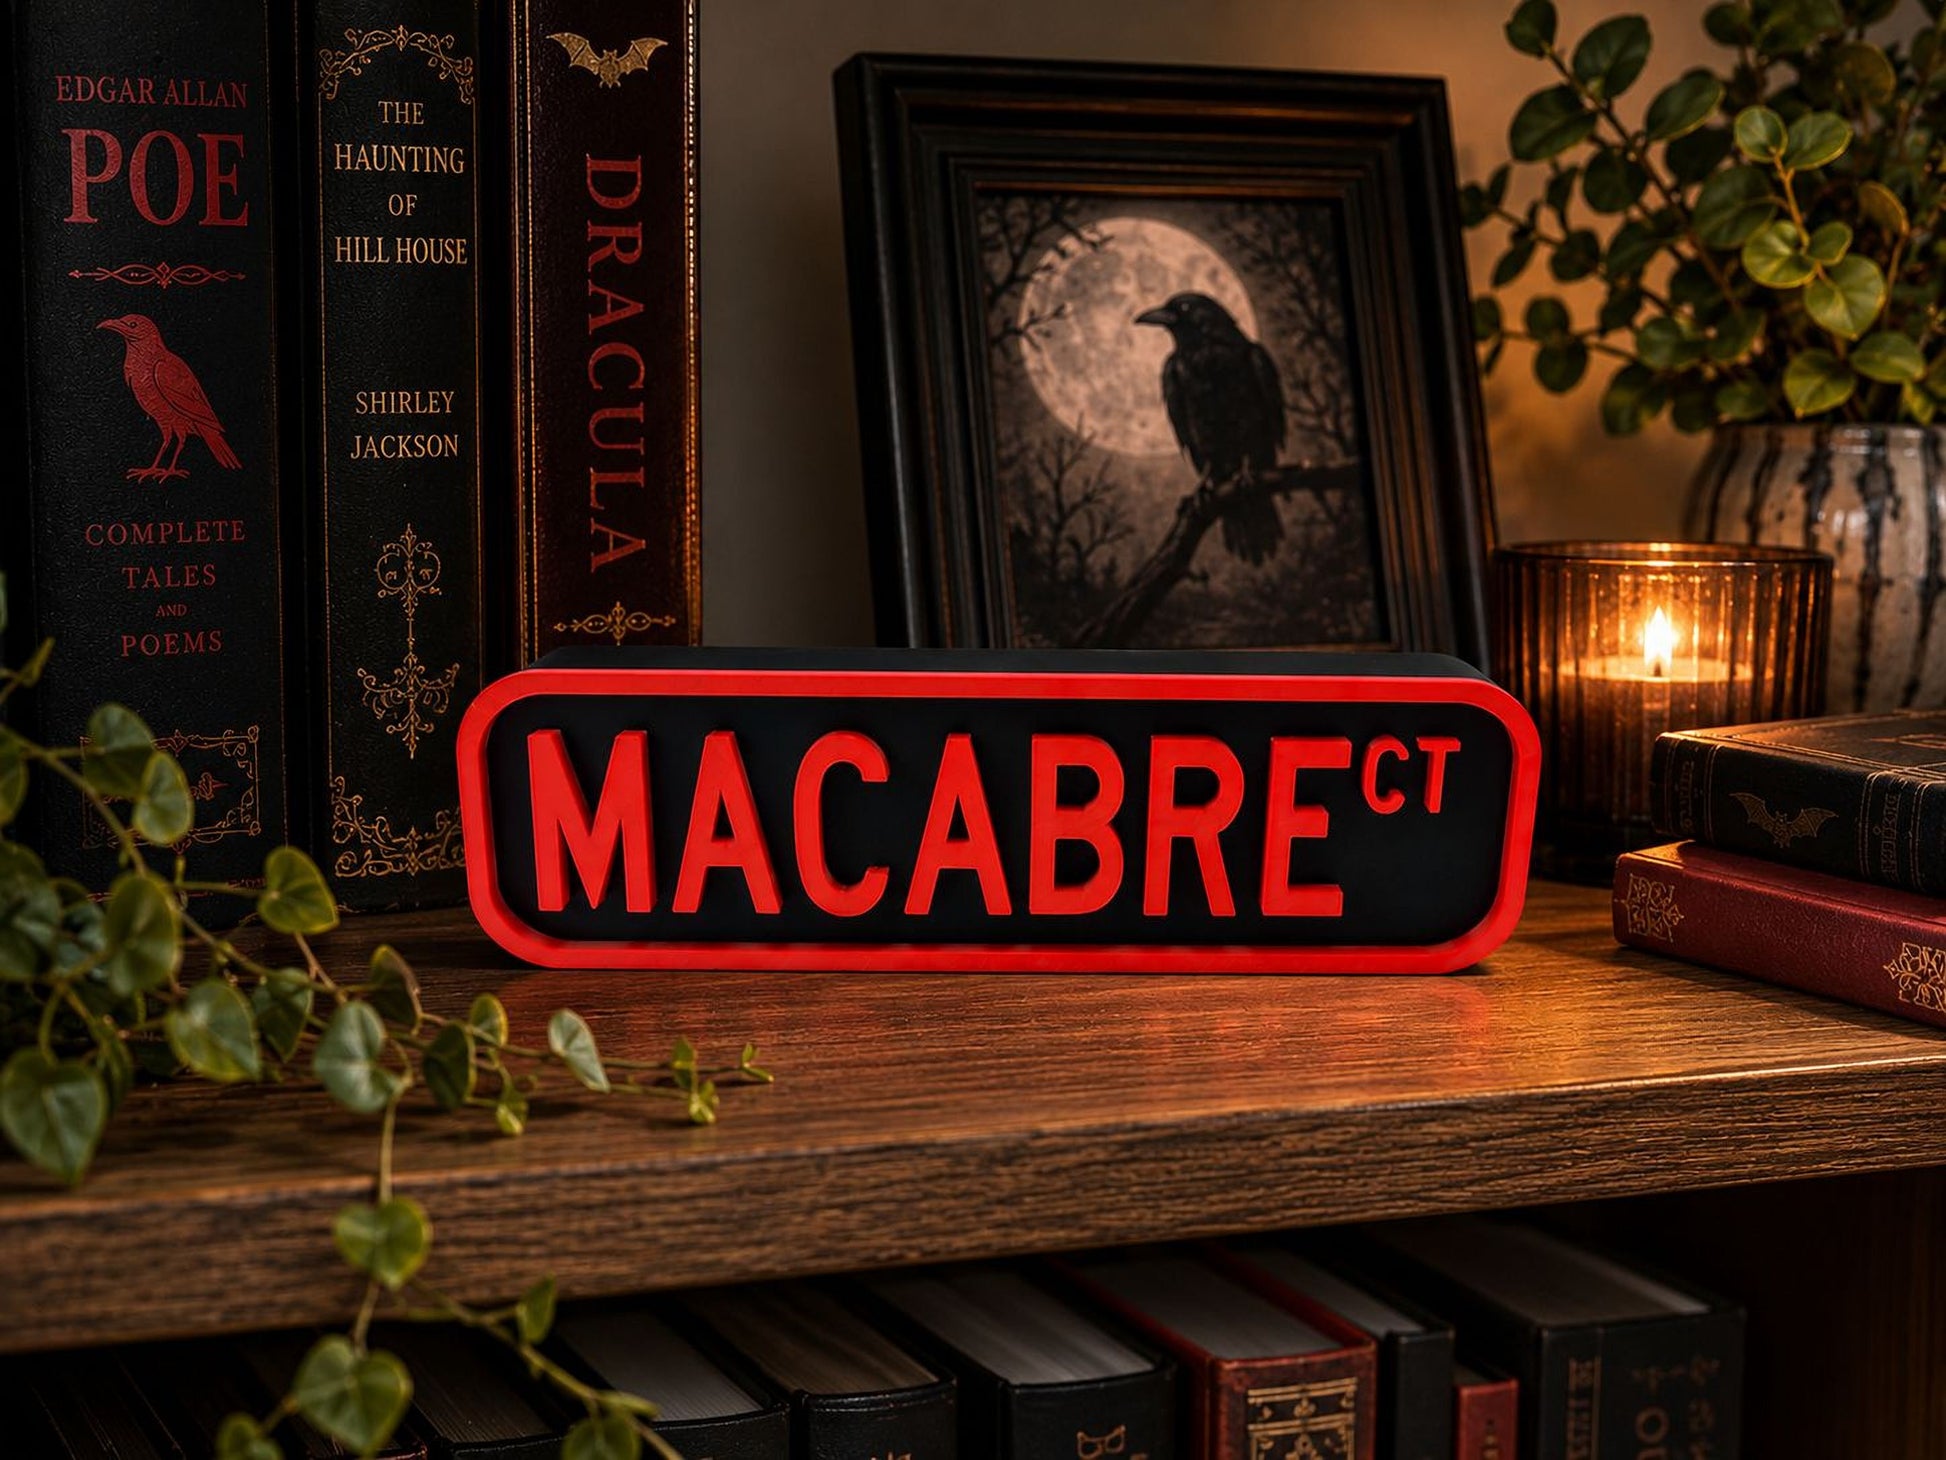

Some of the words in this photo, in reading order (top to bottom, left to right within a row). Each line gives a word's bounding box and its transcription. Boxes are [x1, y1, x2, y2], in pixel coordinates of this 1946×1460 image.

[55, 75, 155, 104] EDGAR
[164, 79, 246, 107] ALLAN
[379, 101, 424, 125] THE
[334, 143, 465, 174] HAUNTING
[62, 128, 248, 226] POE
[388, 193, 418, 217] OF
[335, 236, 390, 263] HILL
[395, 237, 468, 264] HOUSE
[585, 152, 647, 572] DRACULA
[355, 391, 455, 415] SHIRLEY
[350, 434, 458, 459] JACKSON
[85, 520, 245, 546] COMPLETE
[122, 563, 216, 589] TALES
[156, 603, 187, 617] AND
[121, 630, 222, 657] POEMS
[527, 729, 1353, 917] MACABRE
[1362, 736, 1462, 815] CT
